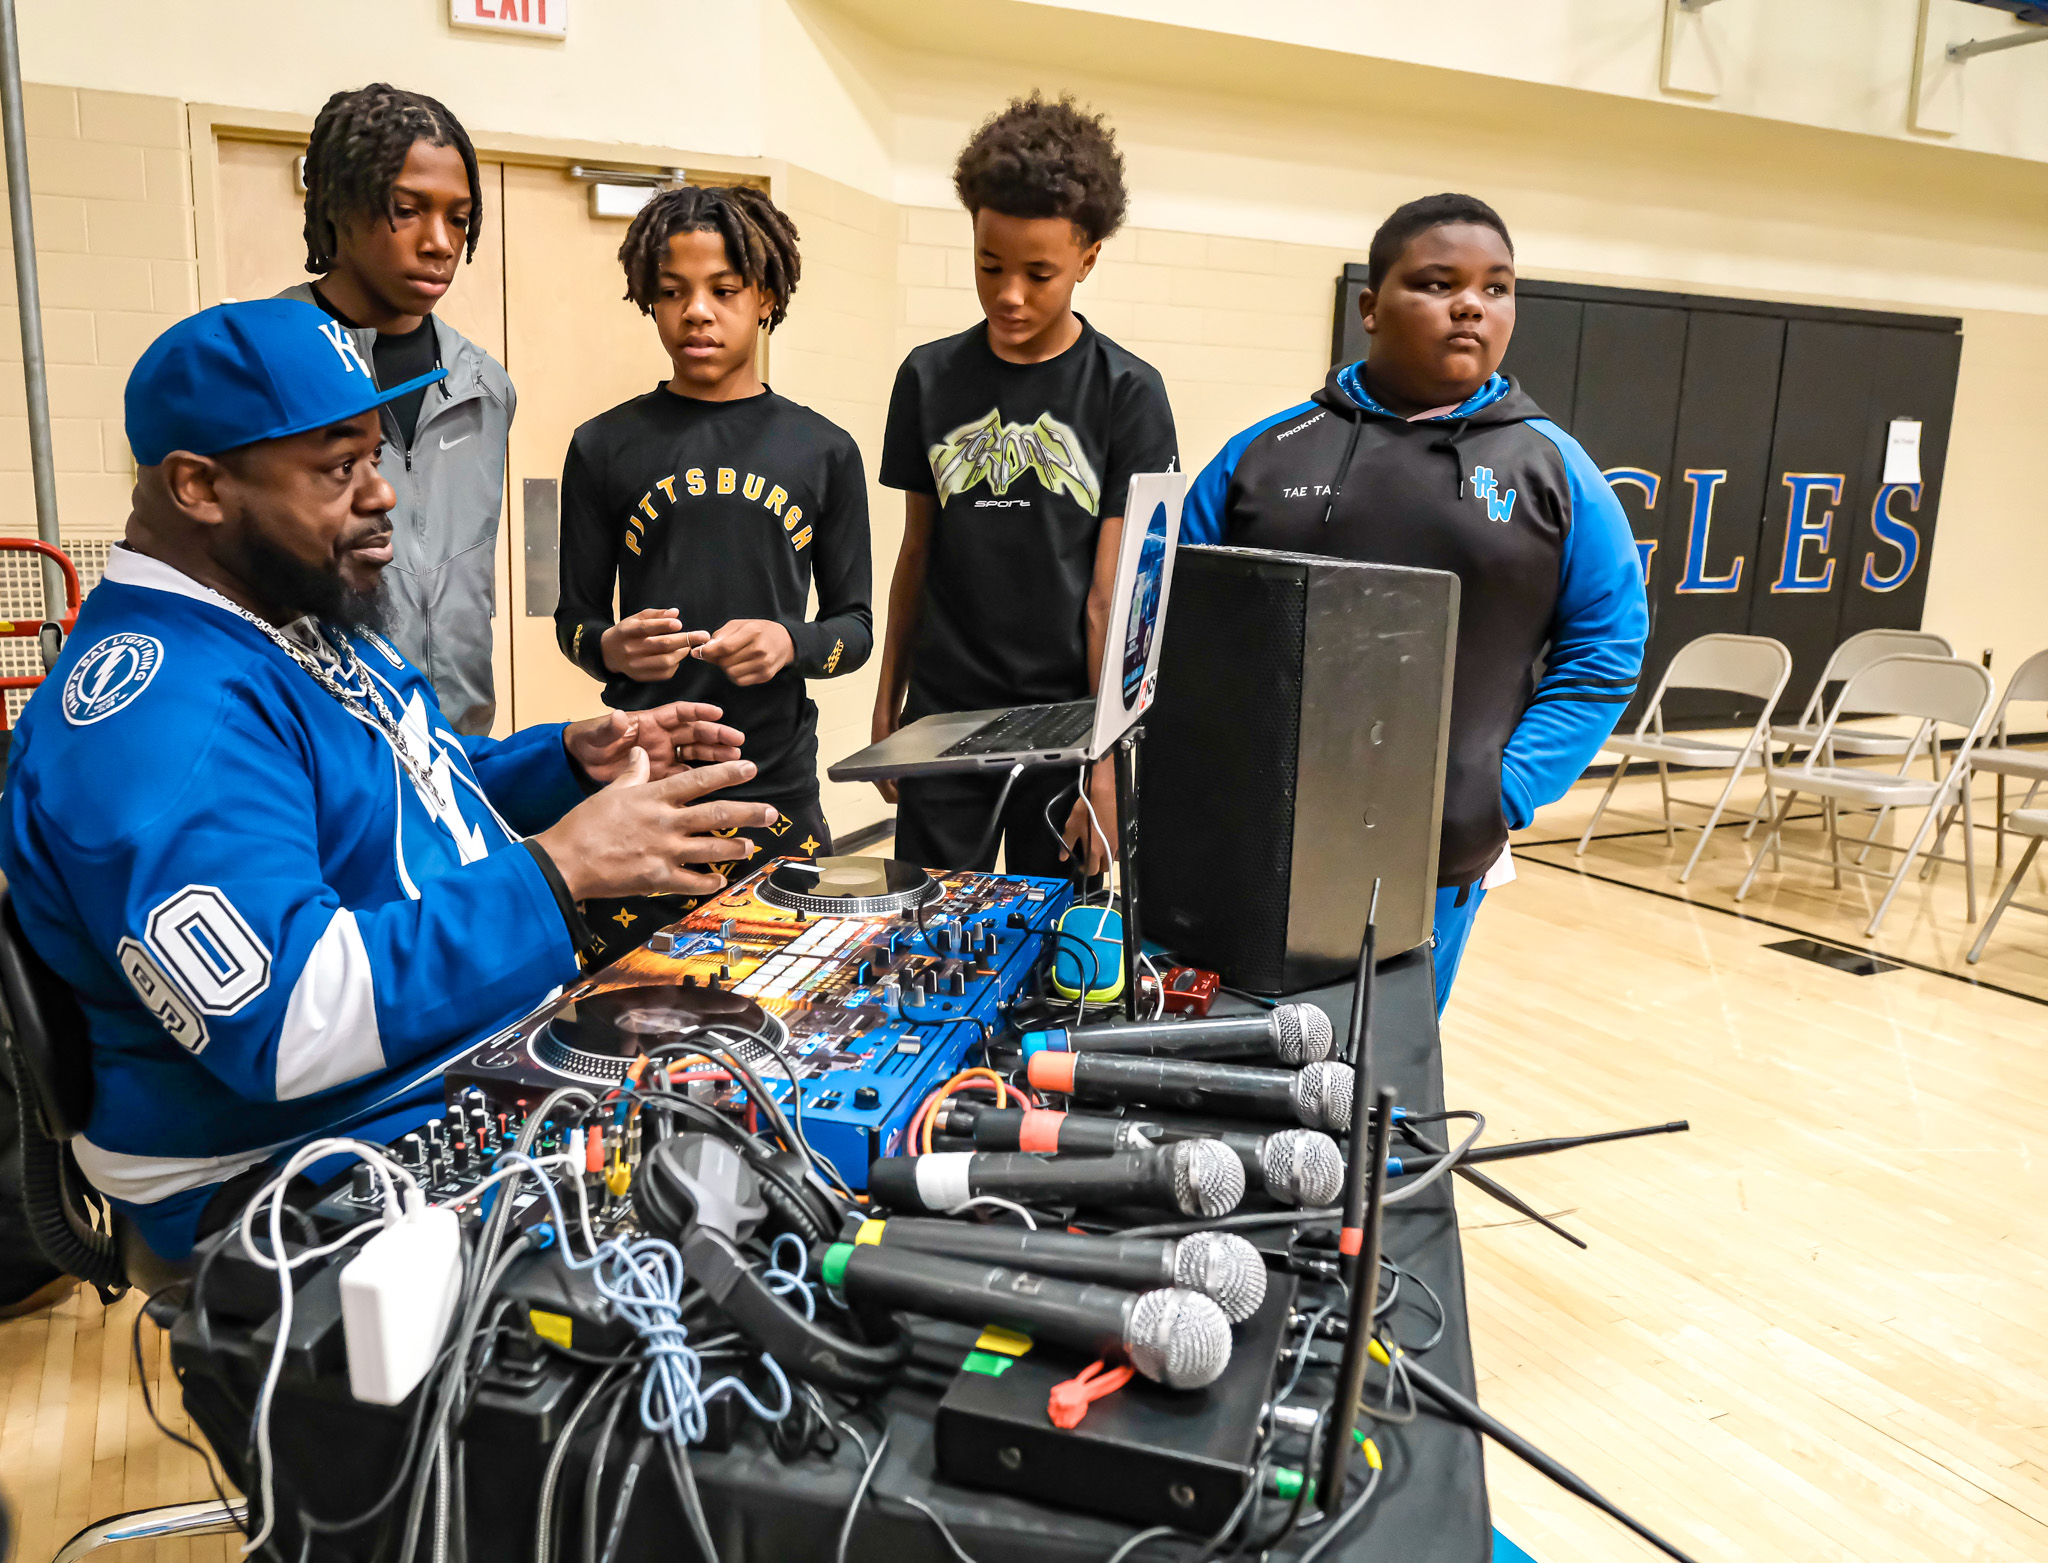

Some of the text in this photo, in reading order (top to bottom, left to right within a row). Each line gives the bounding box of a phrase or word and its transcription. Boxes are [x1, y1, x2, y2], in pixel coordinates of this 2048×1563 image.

[1276, 411, 1327, 441] PROKNIT
[625, 467, 813, 556] PITTSBURGH
[1283, 484, 1341, 498] TAE TA
[66, 635, 156, 715] TAMPA BAY LIGHTNING
